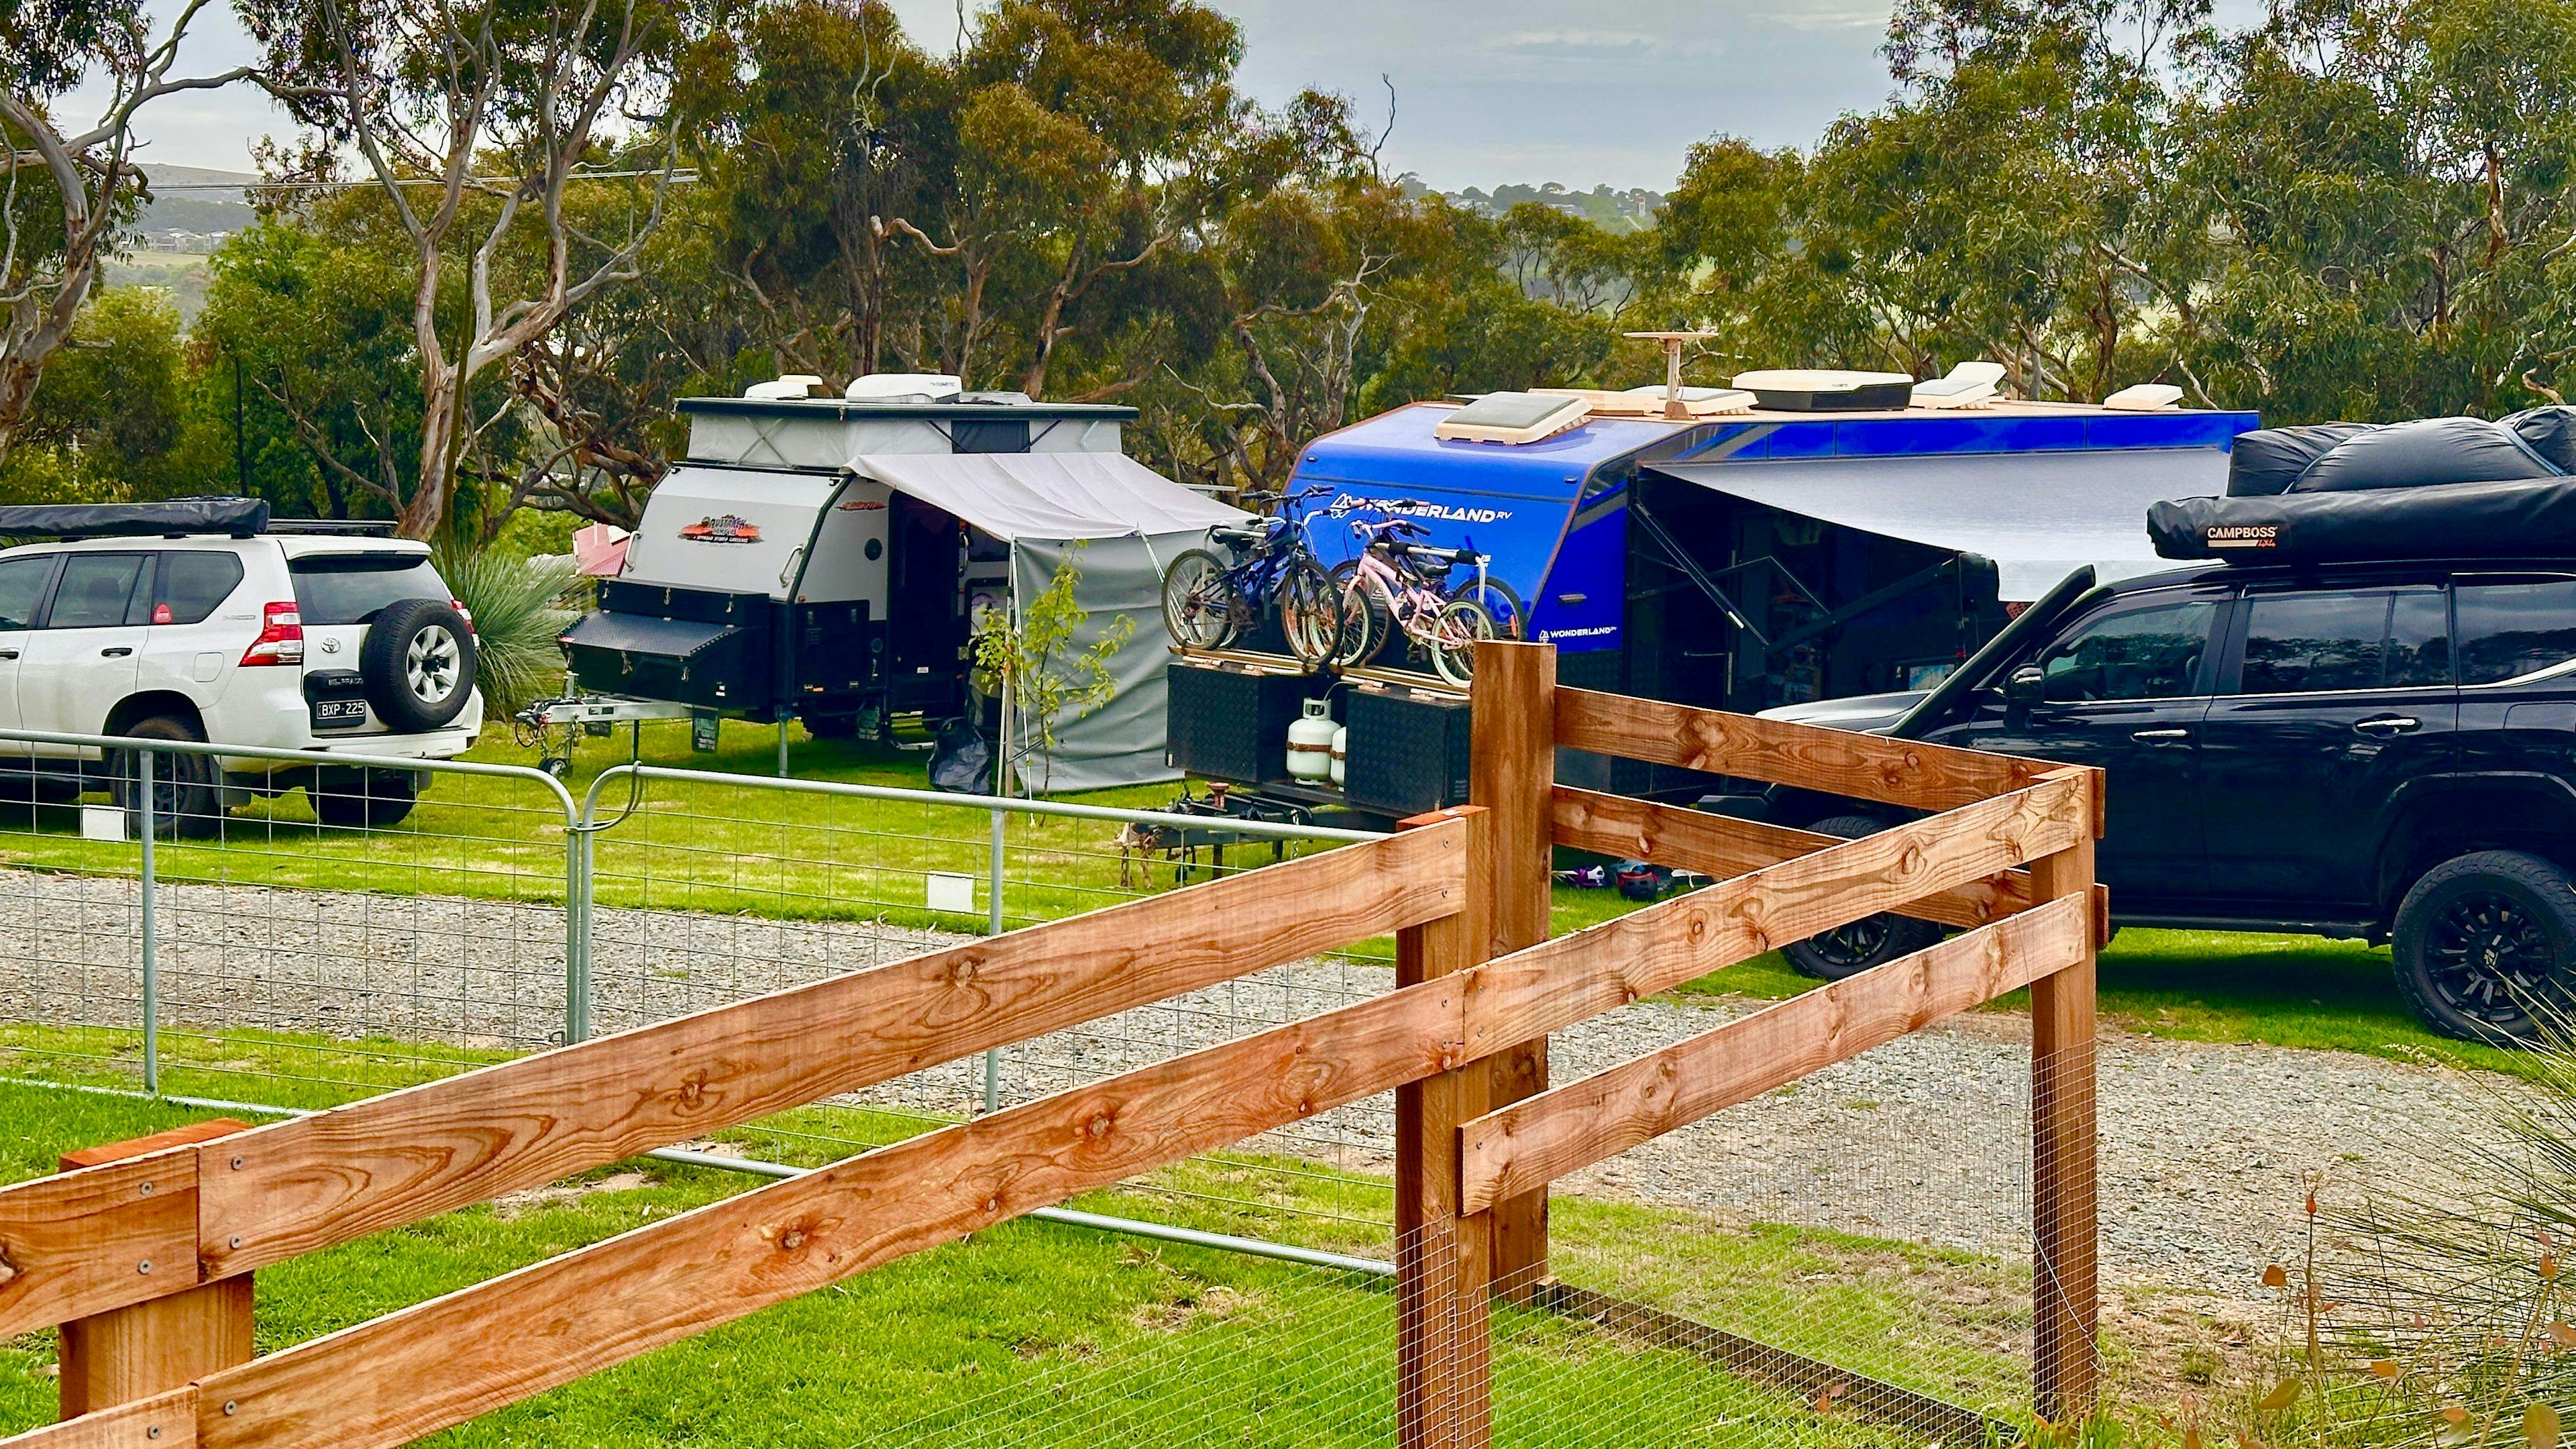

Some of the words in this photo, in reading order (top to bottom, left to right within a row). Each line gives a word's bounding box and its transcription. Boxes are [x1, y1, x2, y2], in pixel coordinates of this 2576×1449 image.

[1496, 511, 1513, 520] RV
[2207, 526, 2277, 539] CAMPBOSS
[1550, 627, 1611, 639] WONDERLAND
[322, 704, 341, 716] BXP
[345, 702, 364, 714] 225
